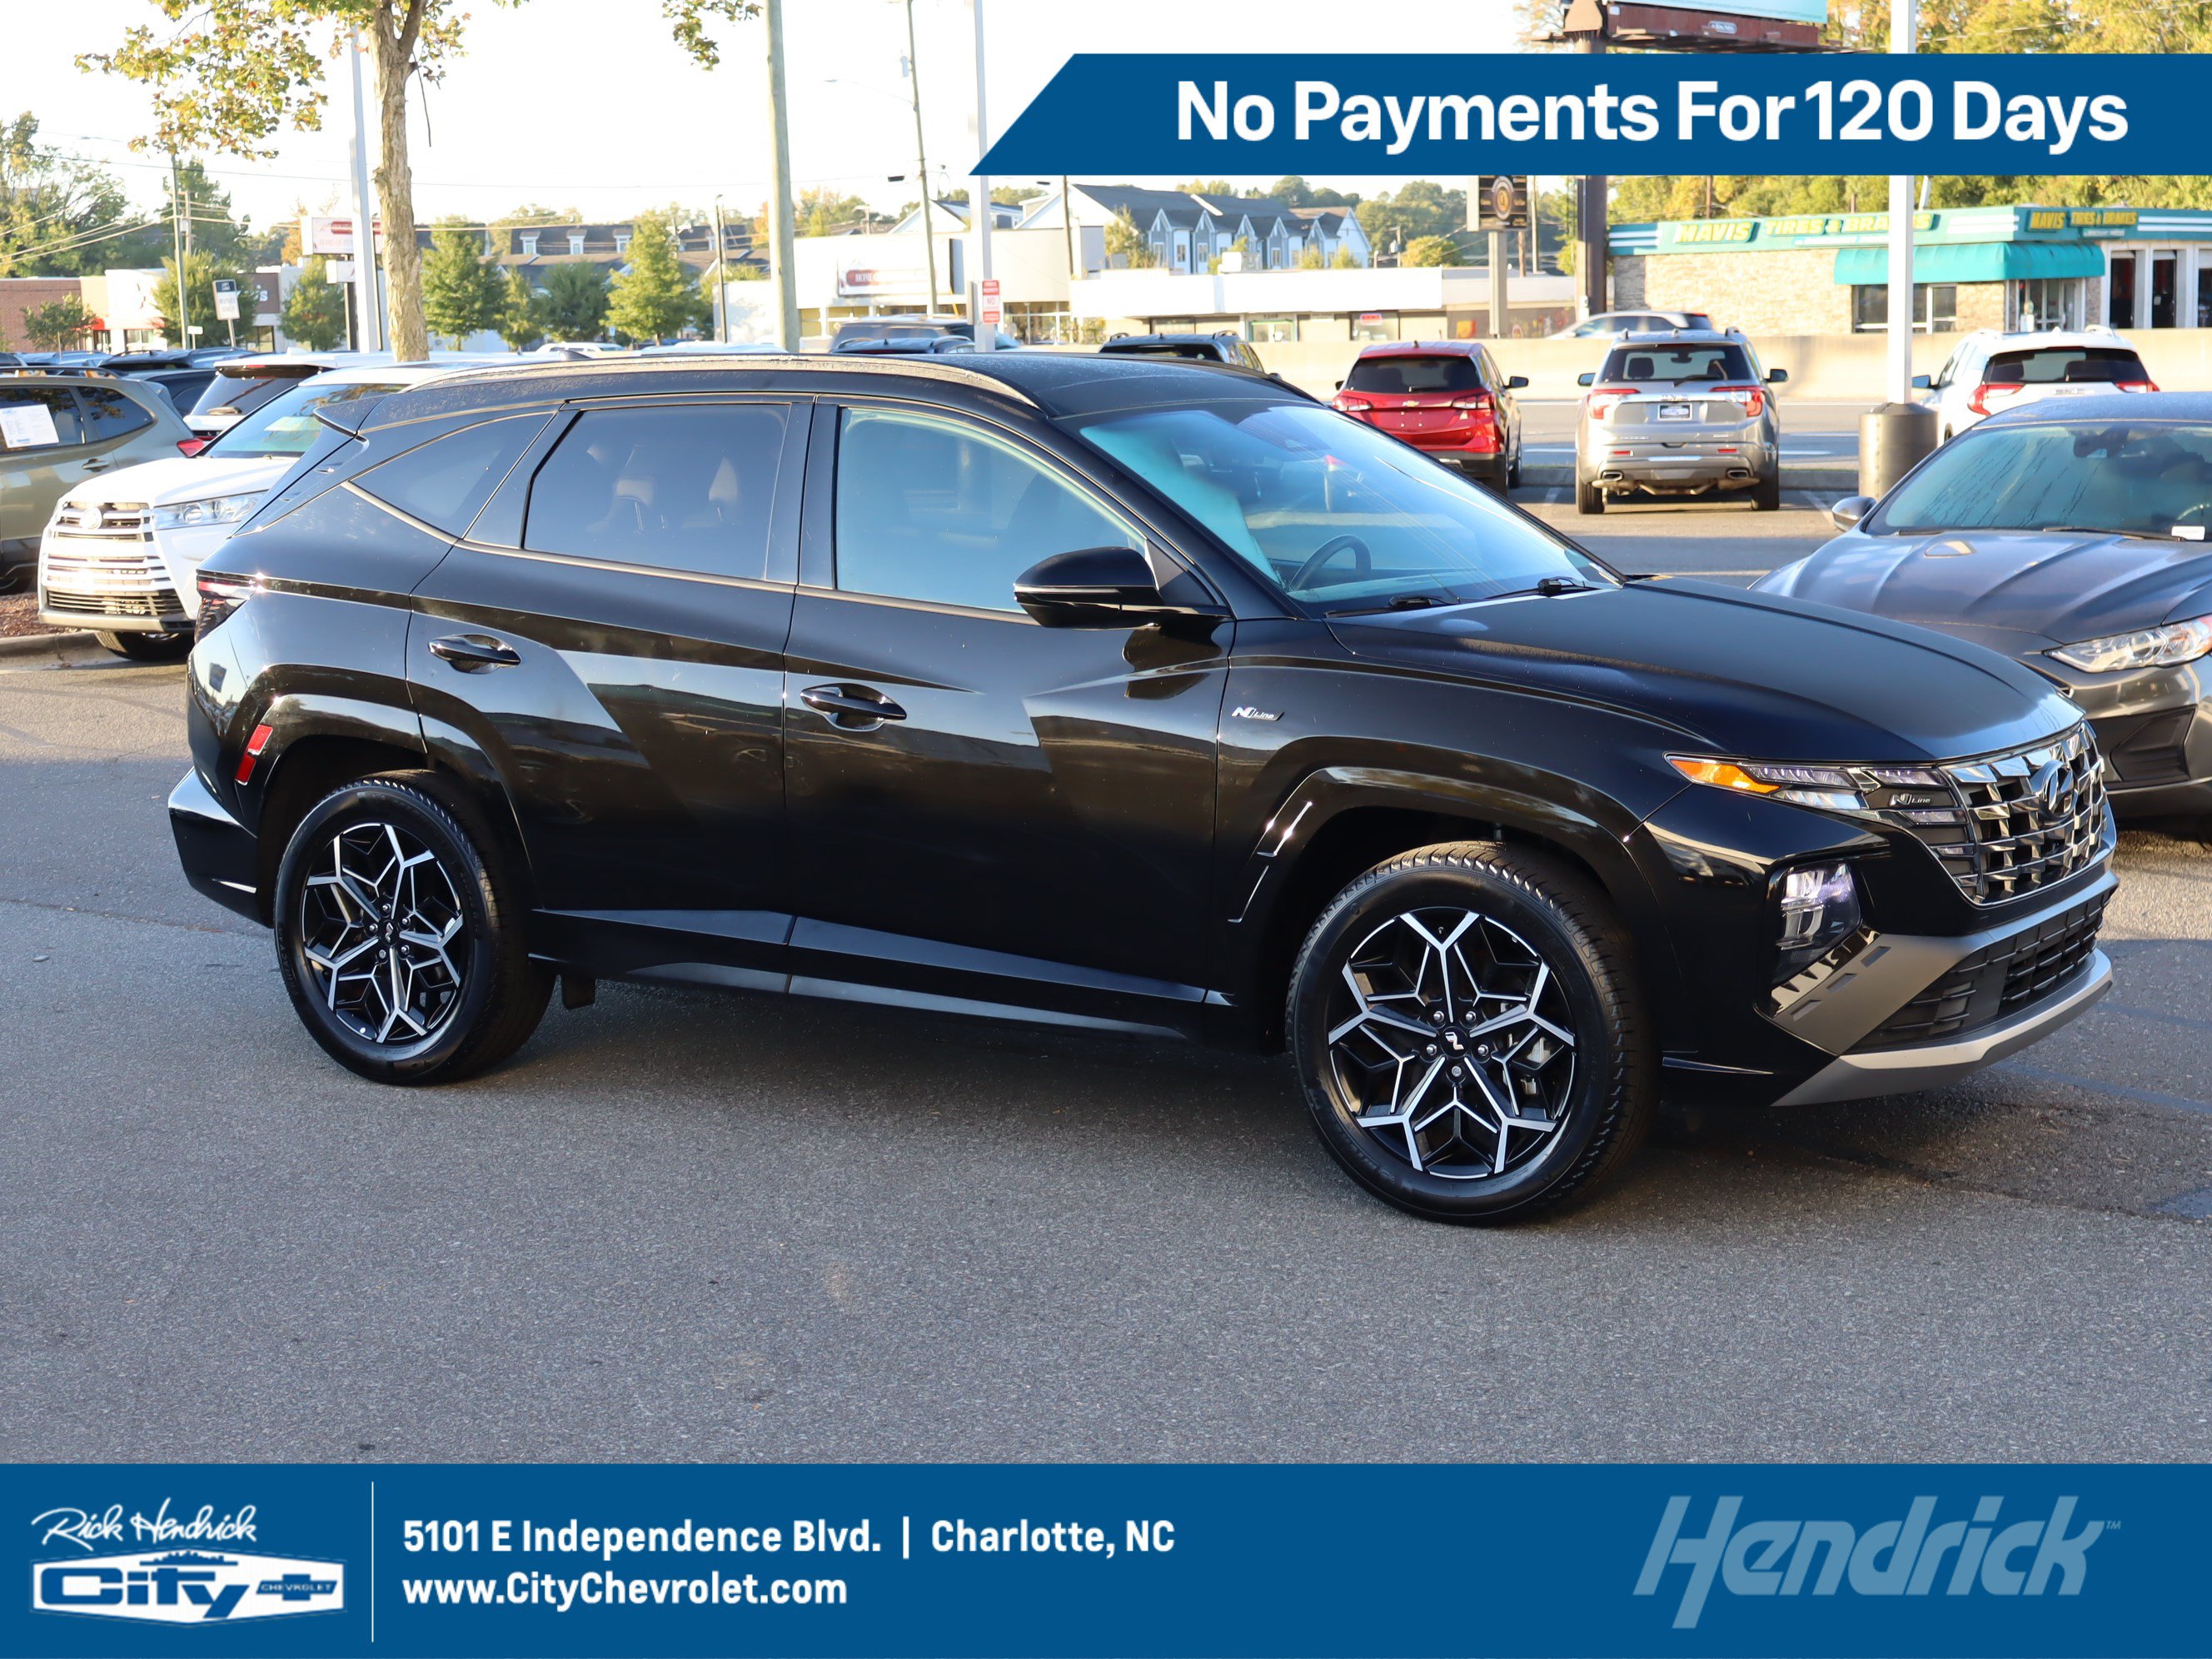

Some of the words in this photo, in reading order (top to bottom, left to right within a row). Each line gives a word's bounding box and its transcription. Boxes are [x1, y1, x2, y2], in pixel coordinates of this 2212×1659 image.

[1676, 221, 1753, 243] MAVIS
[1764, 218, 1826, 236] TIRES
[2030, 212, 2066, 230] MAVIS
